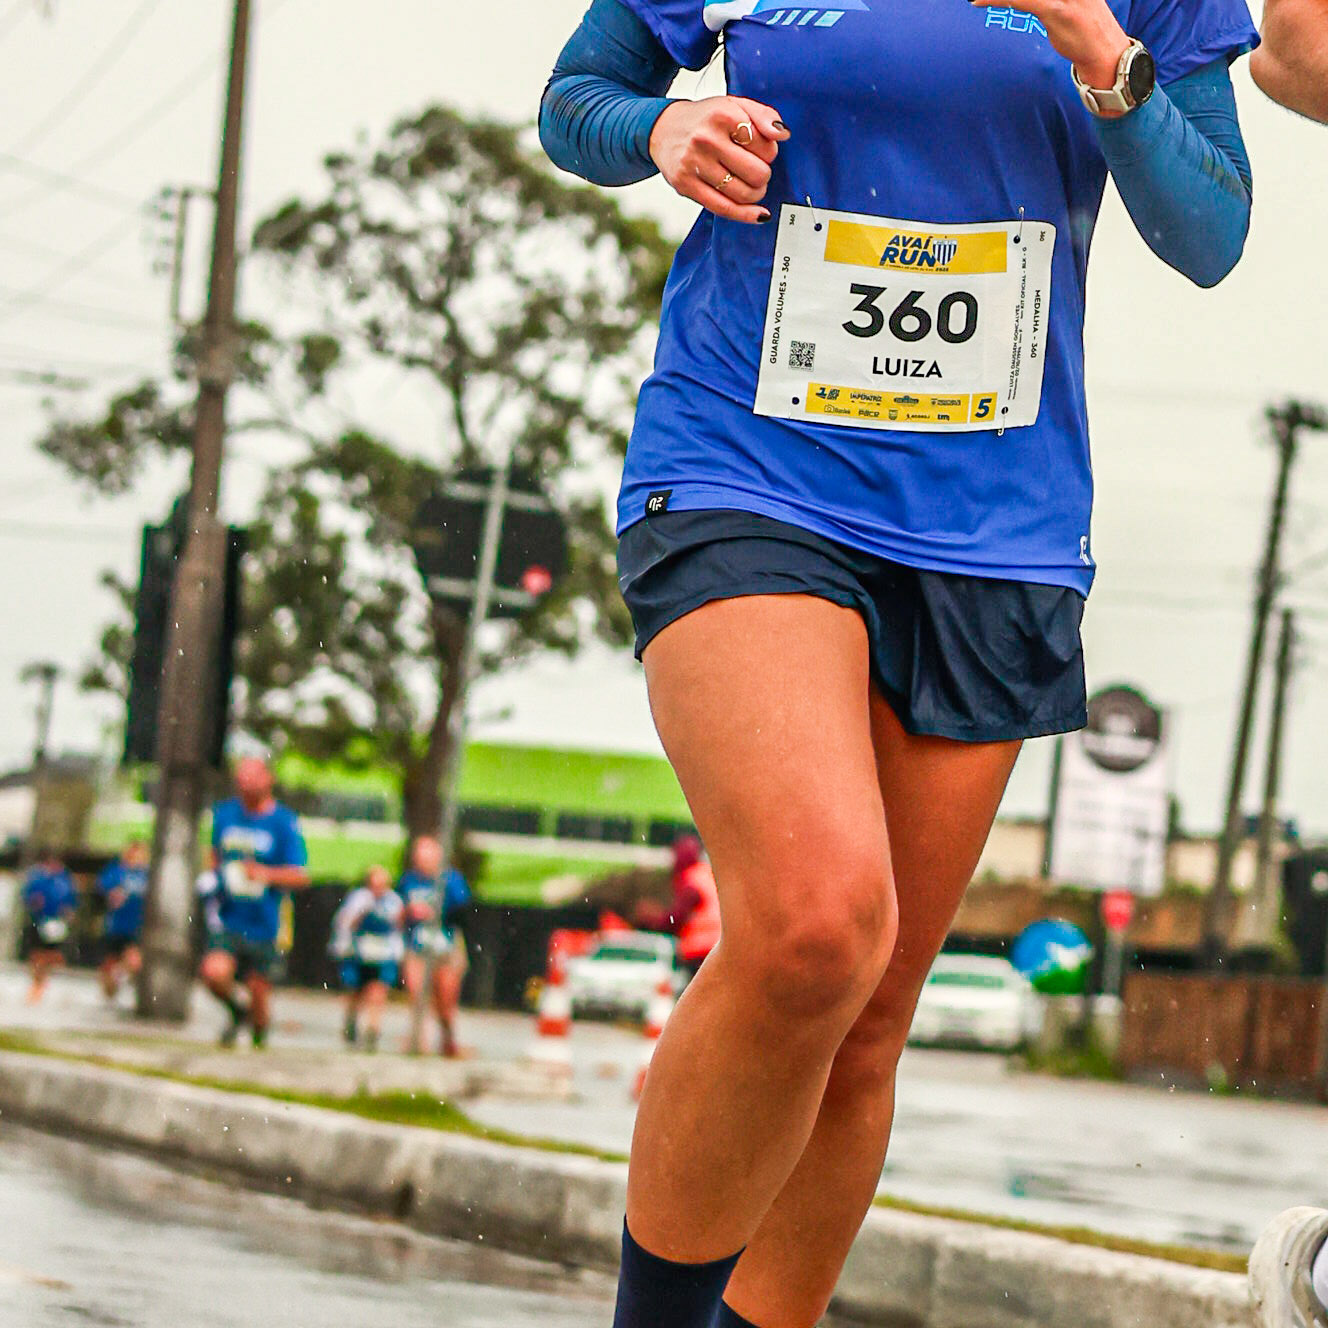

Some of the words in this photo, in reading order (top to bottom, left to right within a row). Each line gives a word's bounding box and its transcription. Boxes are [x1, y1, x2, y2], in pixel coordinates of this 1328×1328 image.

[888, 235, 933, 250] AVAÍ
[782, 256, 791, 272] 360
[879, 246, 936, 267] RUN
[774, 281, 787, 324] VOLUMES
[842, 283, 978, 343] 360
[1033, 289, 1041, 333] MEDALHA
[769, 326, 781, 364] GUARDA
[872, 357, 943, 378] LUIZA
[975, 398, 992, 418] 5
